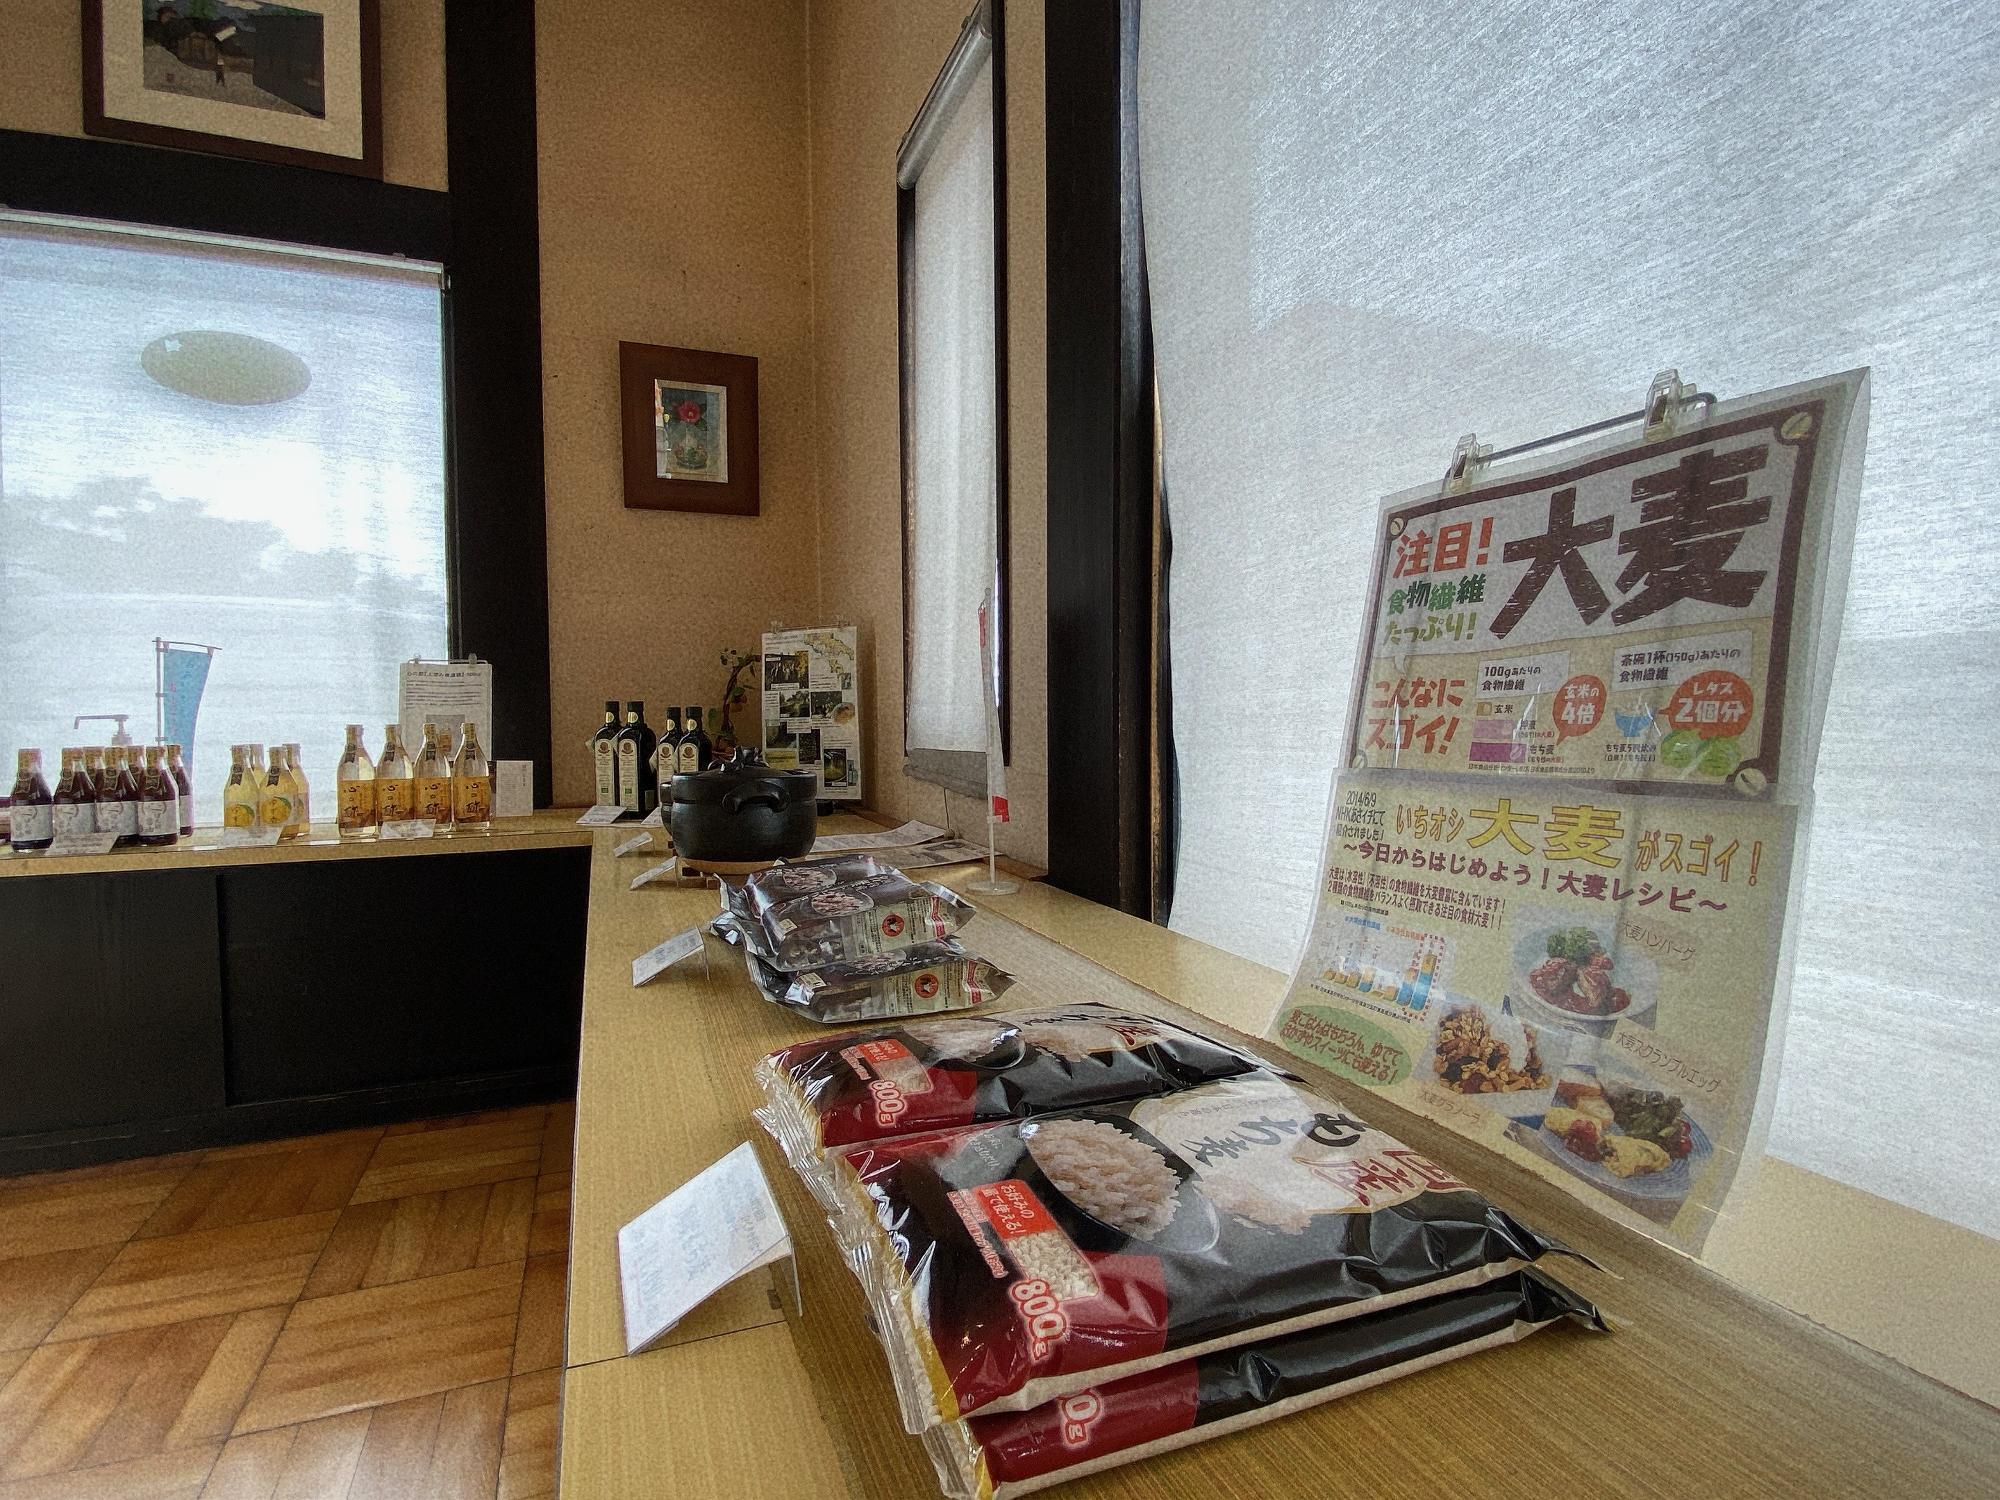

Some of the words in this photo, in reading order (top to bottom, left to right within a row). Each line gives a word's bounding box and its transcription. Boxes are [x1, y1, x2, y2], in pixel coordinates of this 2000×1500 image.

[1392, 516, 1494, 578] 注目!
[1489, 443, 1772, 640] 大麦
[1387, 573, 1486, 615] 食物繊維
[1383, 612, 1476, 645] たっぷり!
[1482, 679, 1525, 691] 食物繊維
[1484, 666, 1541, 678] 100gあたりの
[1619, 667, 1669, 683] 食物繊維
[1693, 681, 1733, 695] レタス
[1371, 677, 1466, 708] こんなに
[1564, 684, 1599, 699] 玄米の
[1494, 704, 1514, 714] 玄米
[1561, 702, 1596, 724] 4倍
[1674, 697, 1746, 723] 2個分
[1365, 714, 1460, 755] スゴイ!
[1622, 921, 1696, 961] 大麦ハンバーグ
[869, 1080, 906, 1127] 800g
[1001, 1184, 1034, 1220] お好みの
[1010, 1278, 1067, 1361] 800g
